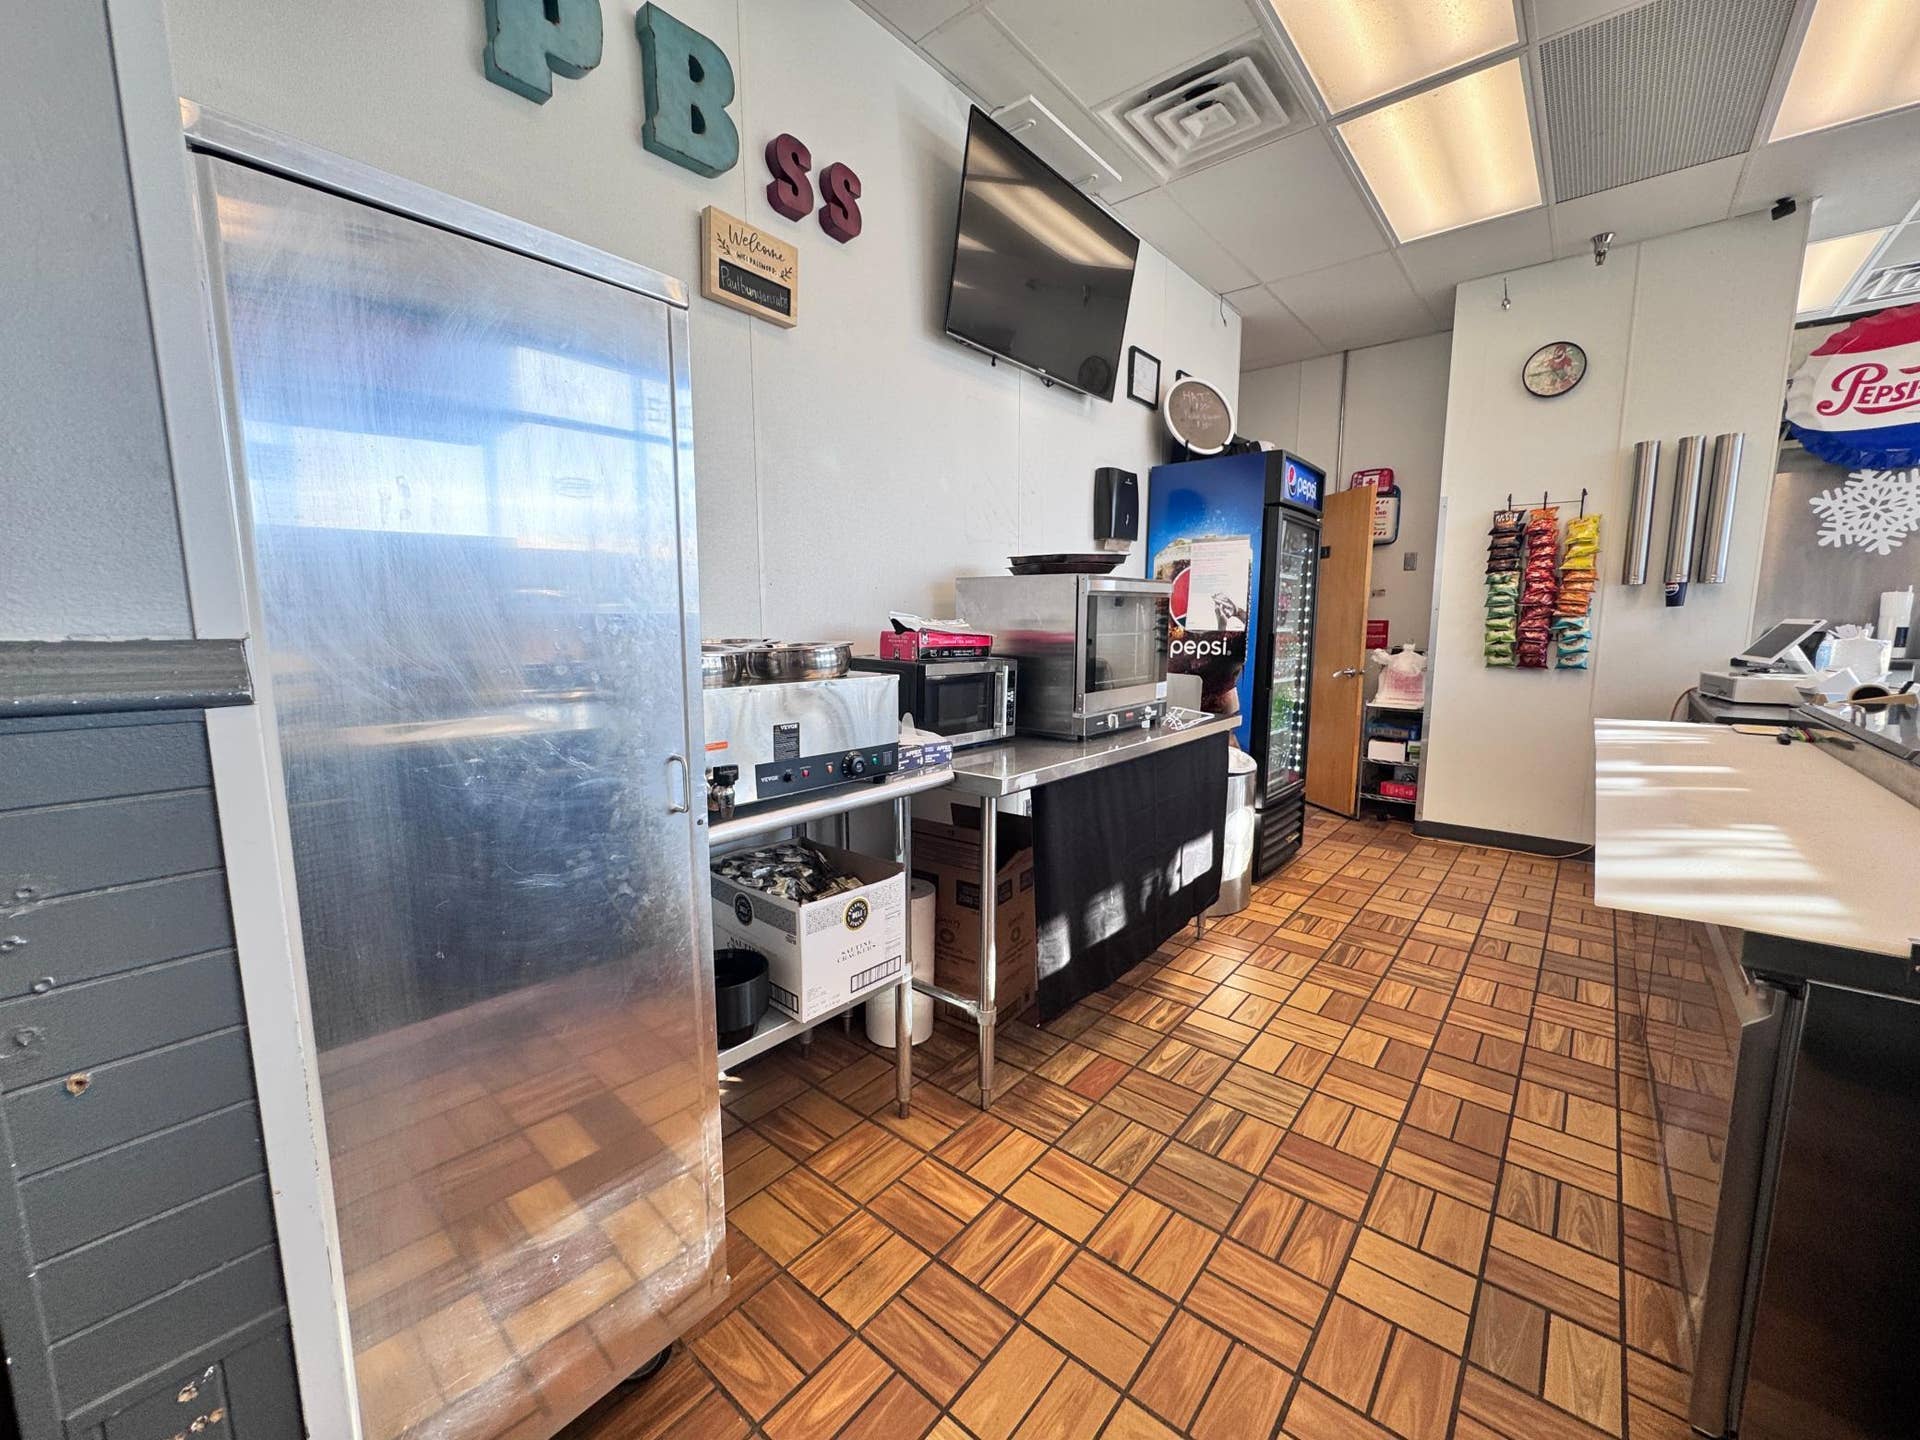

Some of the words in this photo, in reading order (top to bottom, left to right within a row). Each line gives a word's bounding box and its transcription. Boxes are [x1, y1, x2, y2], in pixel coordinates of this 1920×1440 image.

[636, 1, 739, 179] B
[728, 223, 786, 263] Welcome
[1297, 477, 1317, 501] pepsi
[1170, 636, 1227, 659] pepsi
